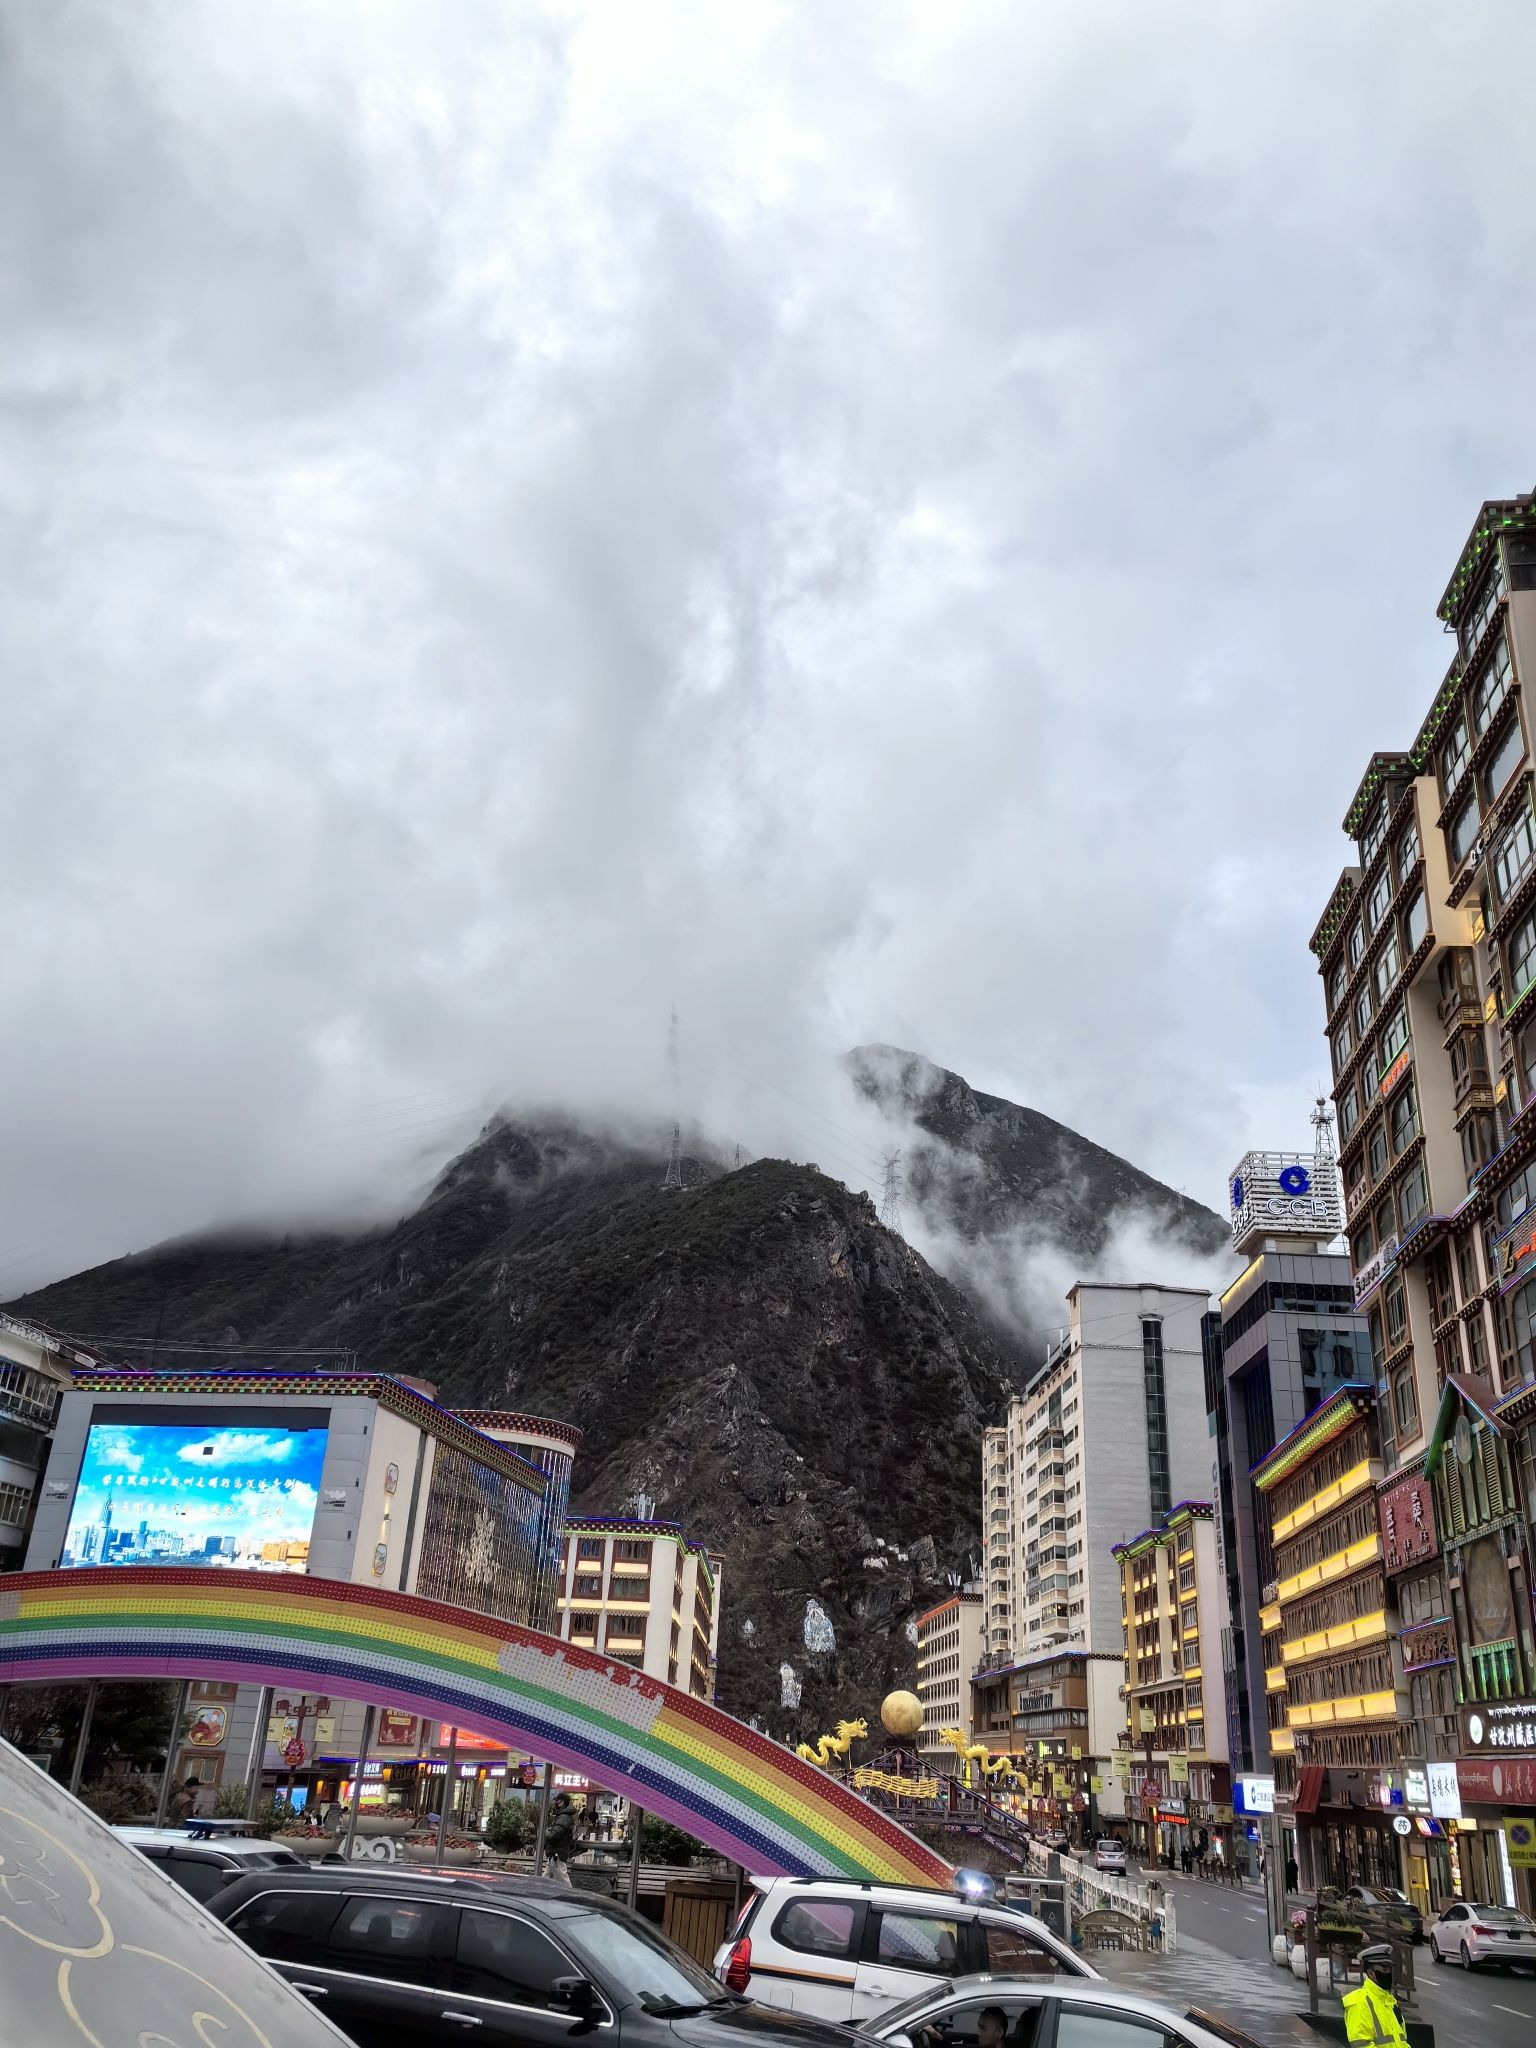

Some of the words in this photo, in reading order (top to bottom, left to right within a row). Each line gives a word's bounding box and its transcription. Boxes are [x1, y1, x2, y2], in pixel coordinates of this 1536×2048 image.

[1266, 1199, 1328, 1216] CCB
[1232, 1205, 1249, 1234] CCB
[1489, 1721, 1536, 1748] 甘孜州藏医
[1397, 1819, 1408, 1832] 药
